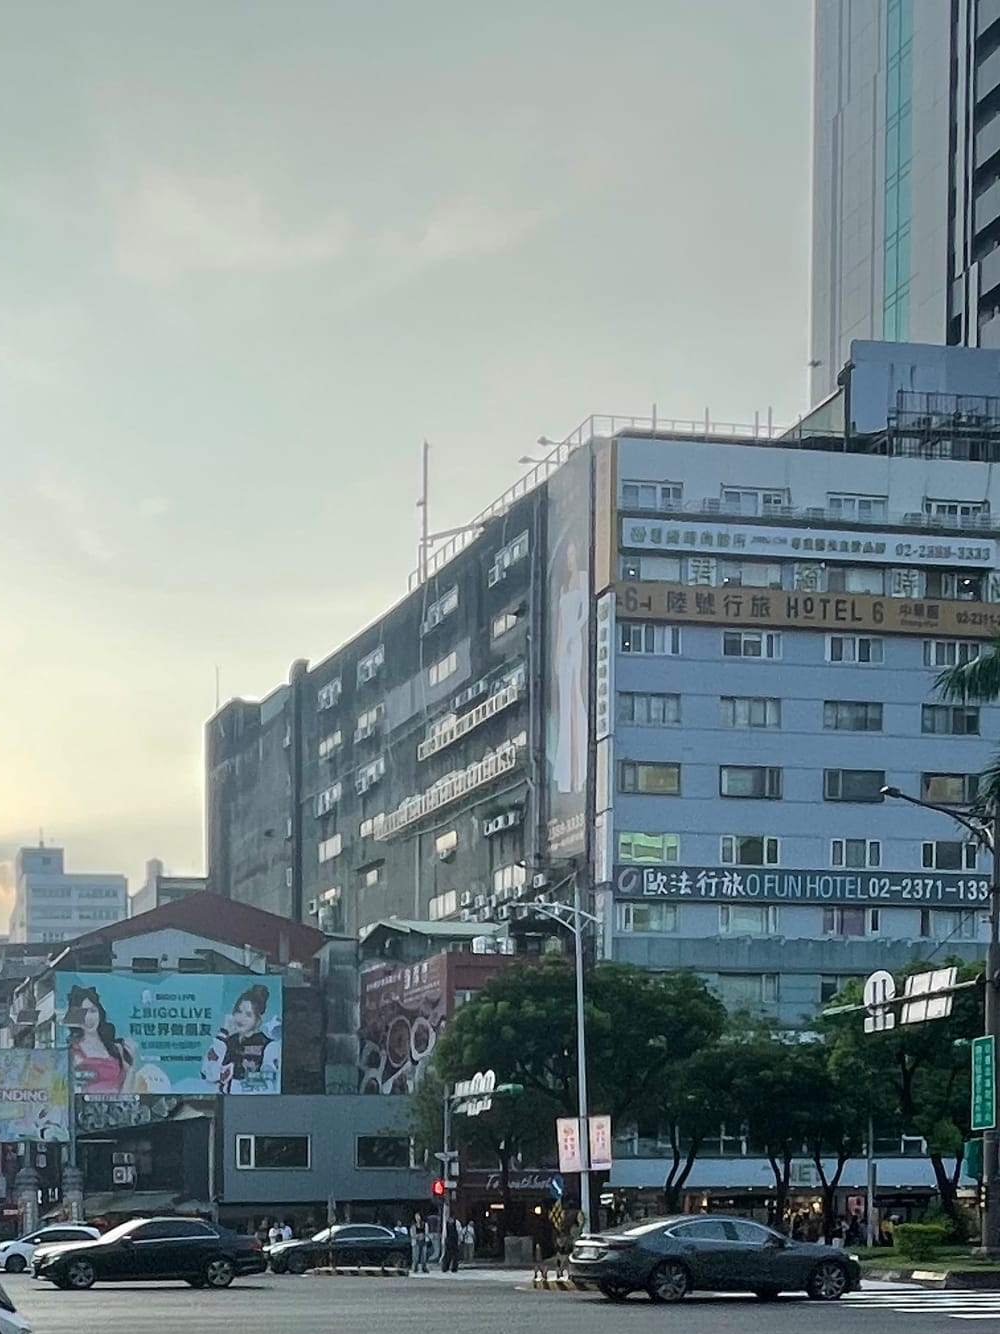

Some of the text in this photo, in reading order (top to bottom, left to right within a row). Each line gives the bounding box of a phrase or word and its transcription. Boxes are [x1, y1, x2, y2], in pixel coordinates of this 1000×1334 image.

[667, 591, 771, 618] 陸號行旅
[872, 601, 884, 624] 6
[764, 874, 800, 897] FUN
[806, 875, 868, 899] HOTEL
[869, 878, 993, 900] 02-2371-133
[181, 1007, 212, 1019] LIVE
